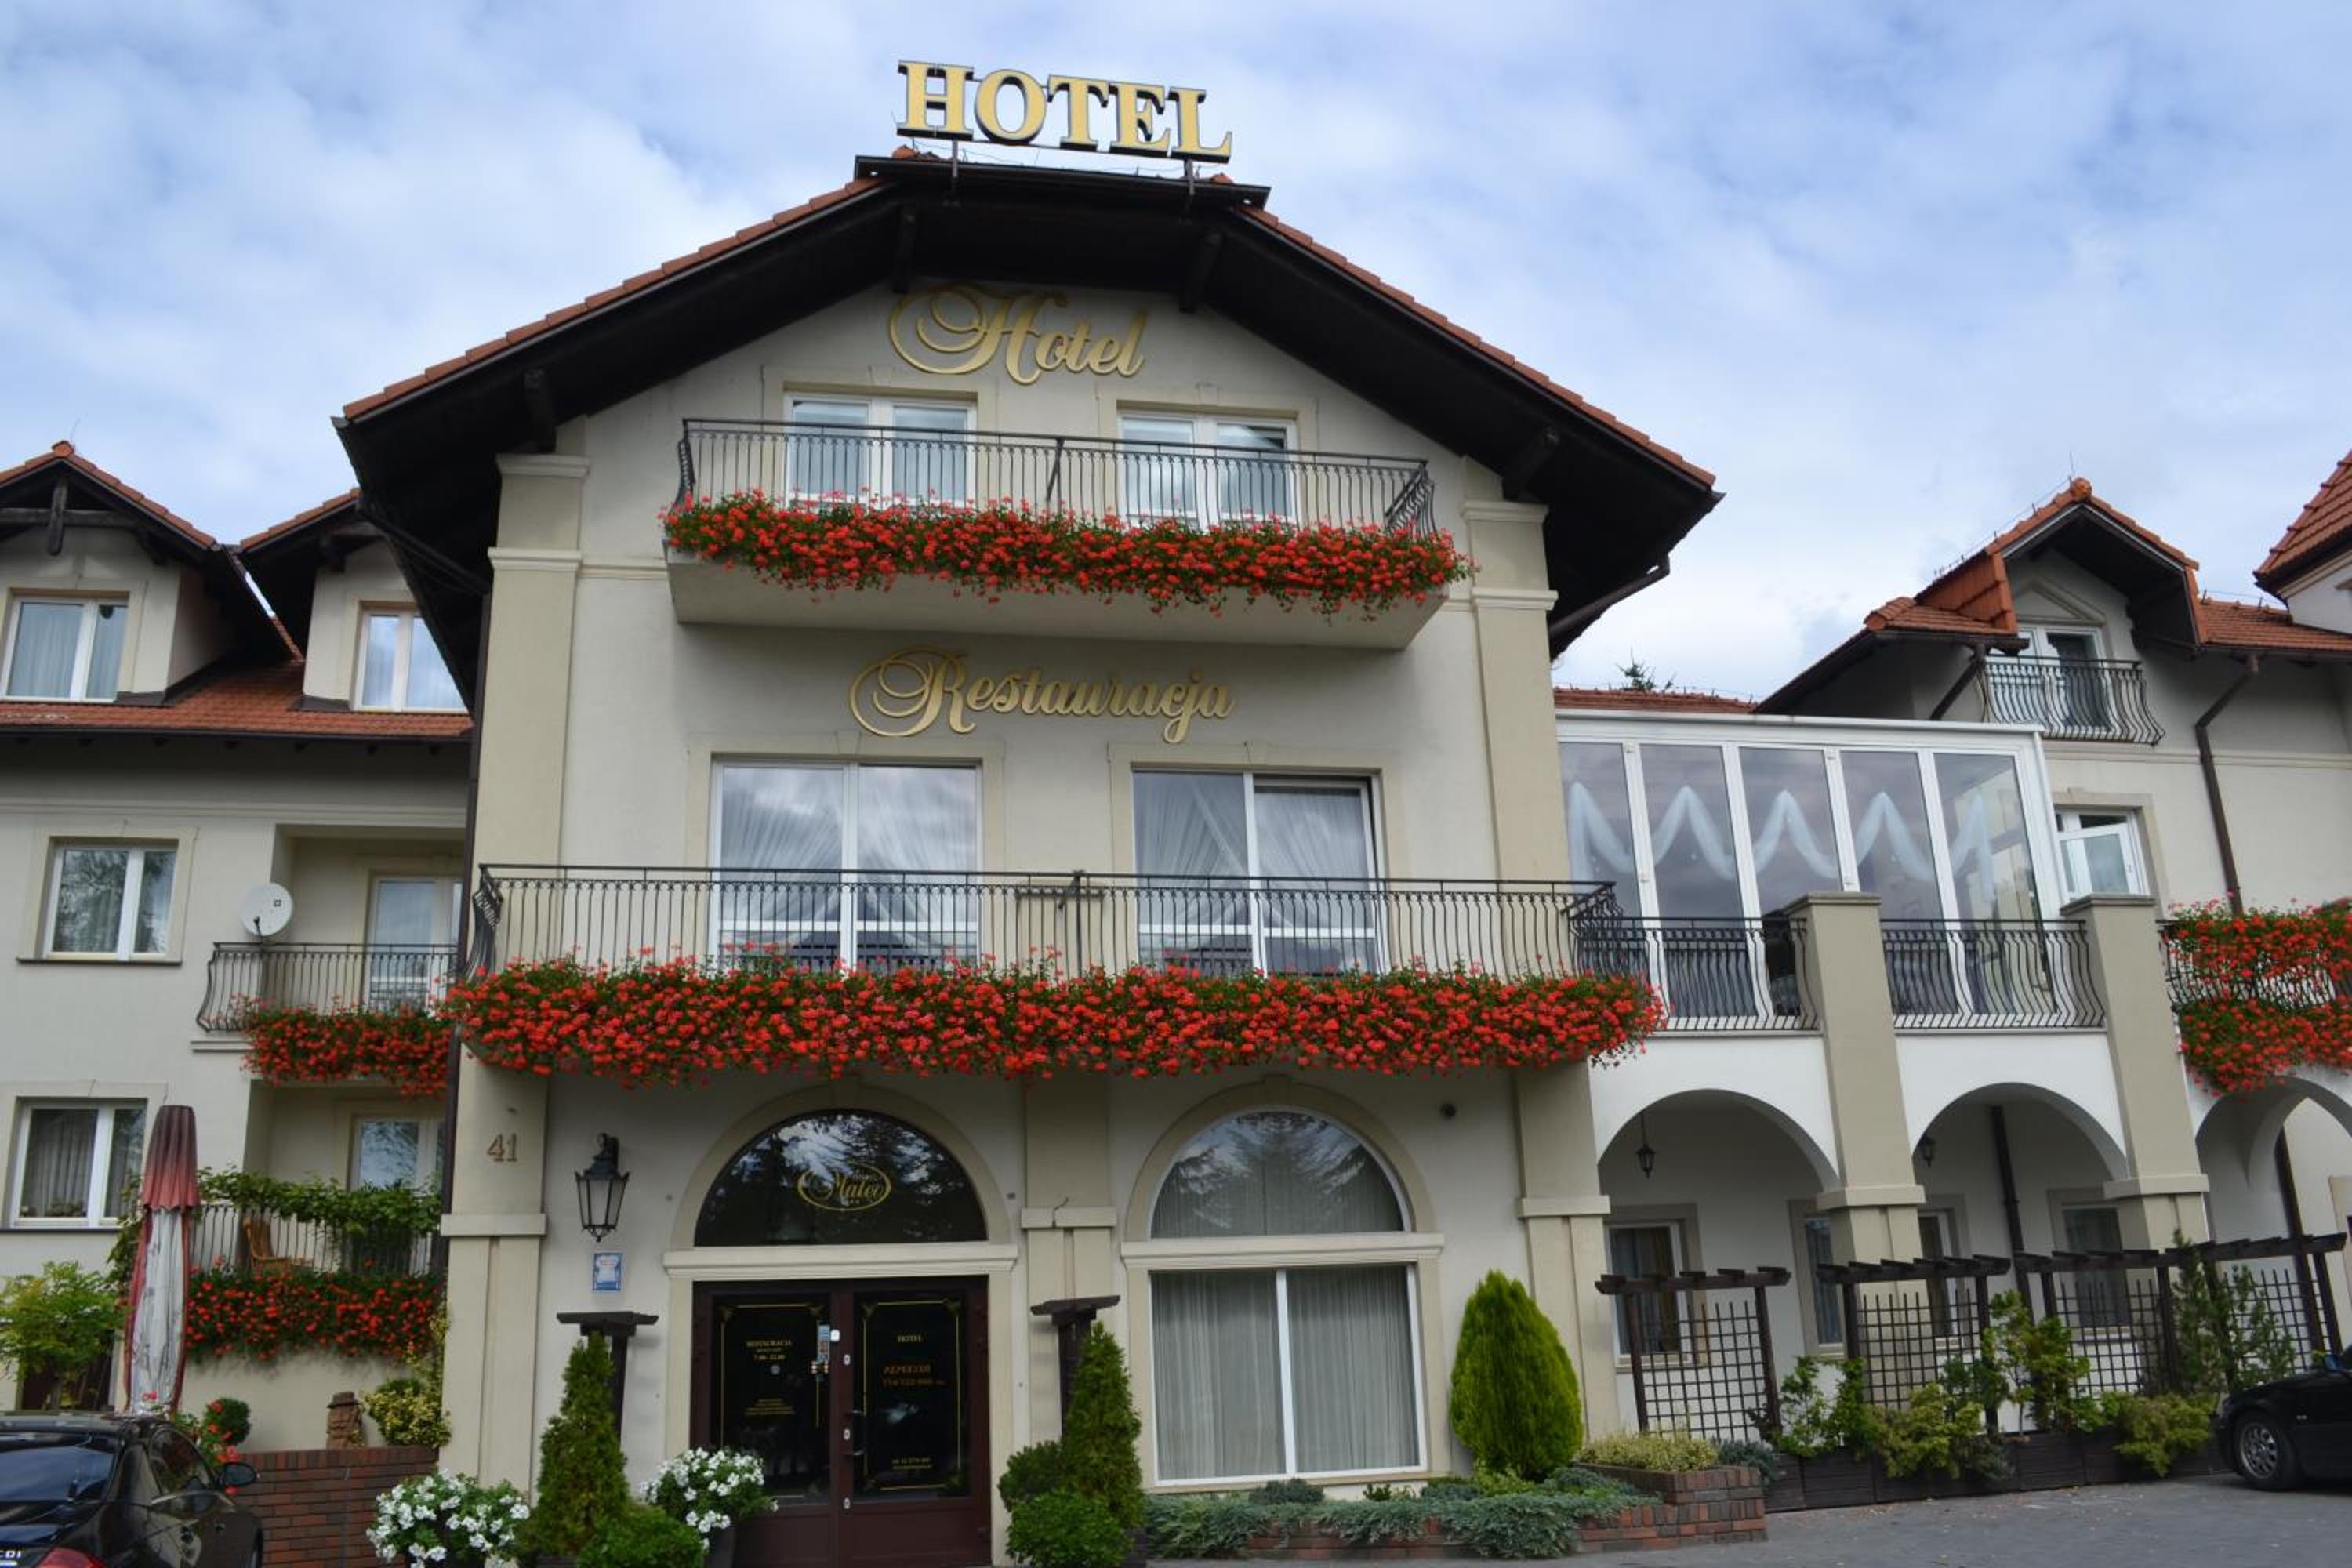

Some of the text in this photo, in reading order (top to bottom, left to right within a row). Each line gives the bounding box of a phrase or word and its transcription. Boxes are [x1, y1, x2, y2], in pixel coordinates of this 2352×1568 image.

[896, 60, 1232, 163] HOTEL
[888, 281, 1148, 385] Hotel
[848, 644, 1236, 744] Restauracja
[486, 1133, 519, 1163] 41
